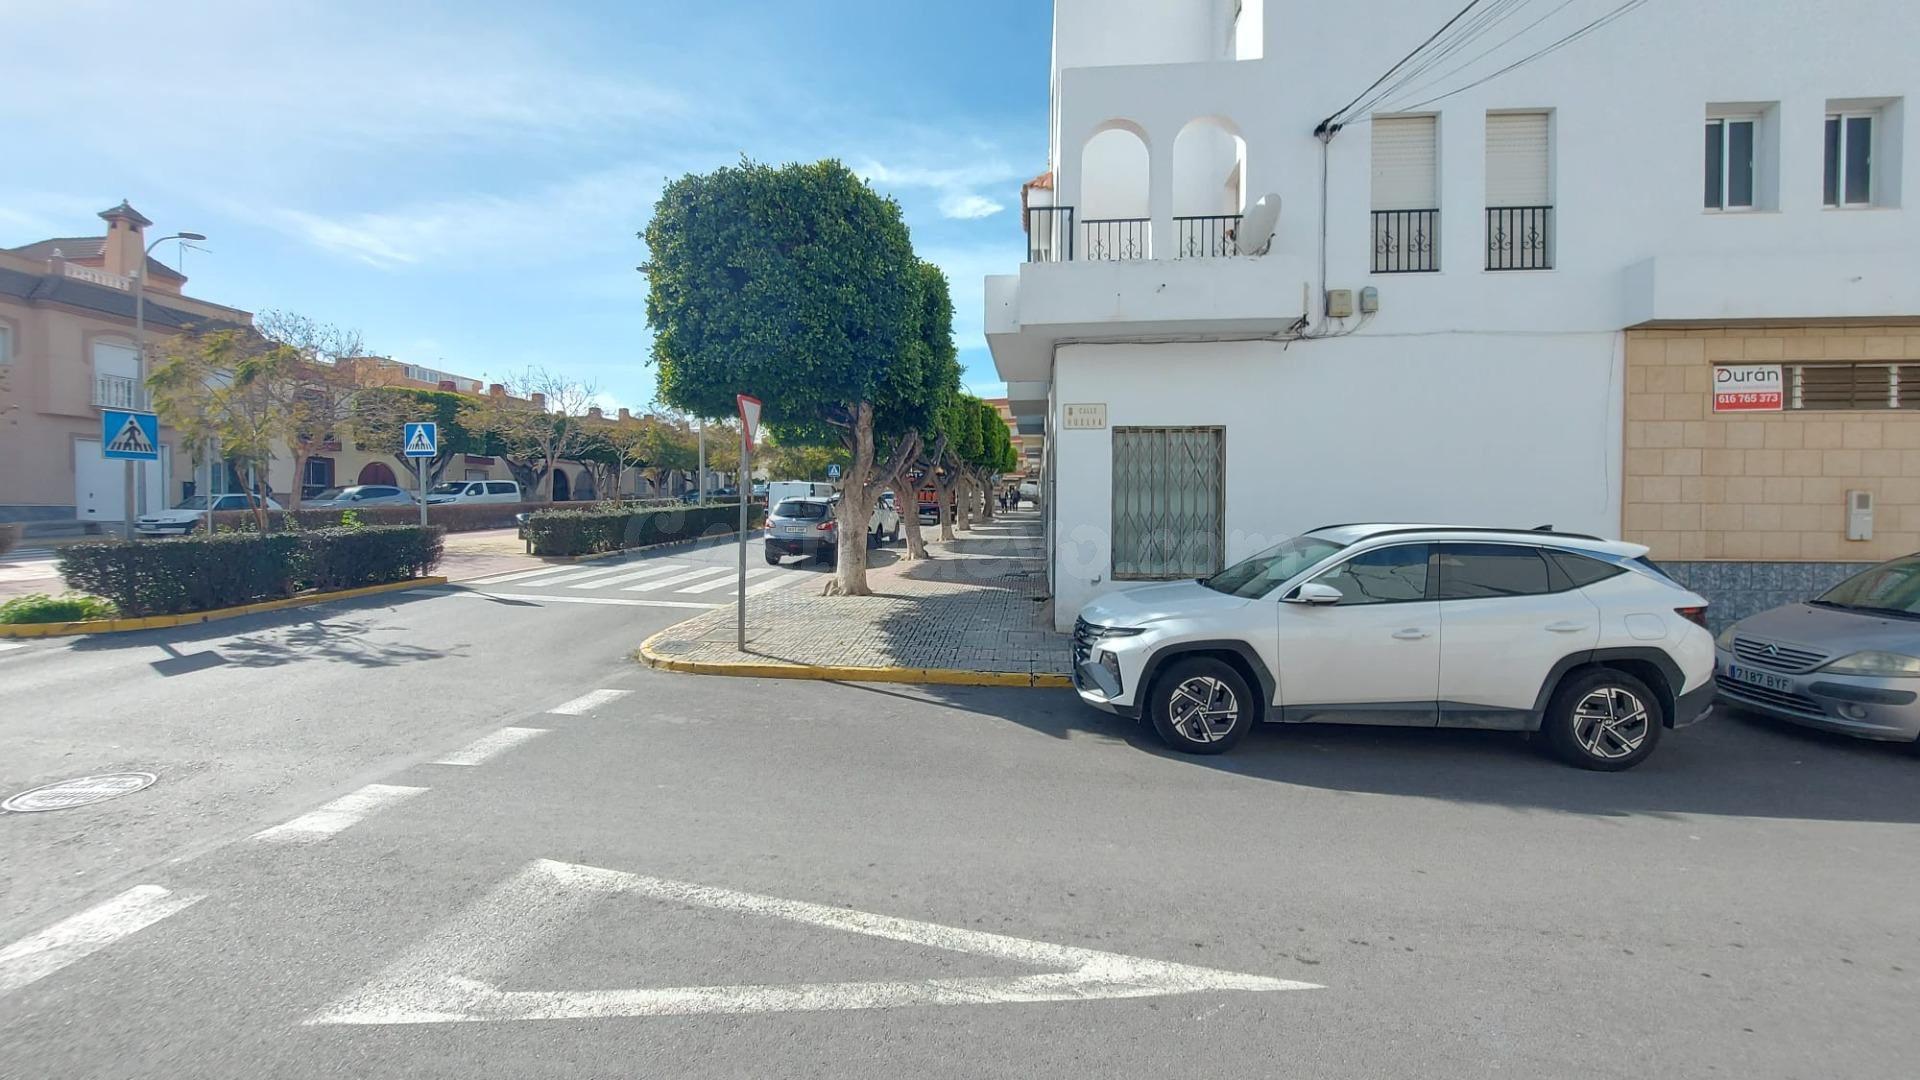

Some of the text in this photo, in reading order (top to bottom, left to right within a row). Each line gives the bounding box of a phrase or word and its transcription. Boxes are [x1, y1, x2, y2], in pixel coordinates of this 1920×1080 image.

[1717, 367, 1779, 382] Durán
[1718, 395, 1736, 403] 616
[1760, 393, 1778, 403] 373
[1736, 668, 1789, 690] 7187 BYF
